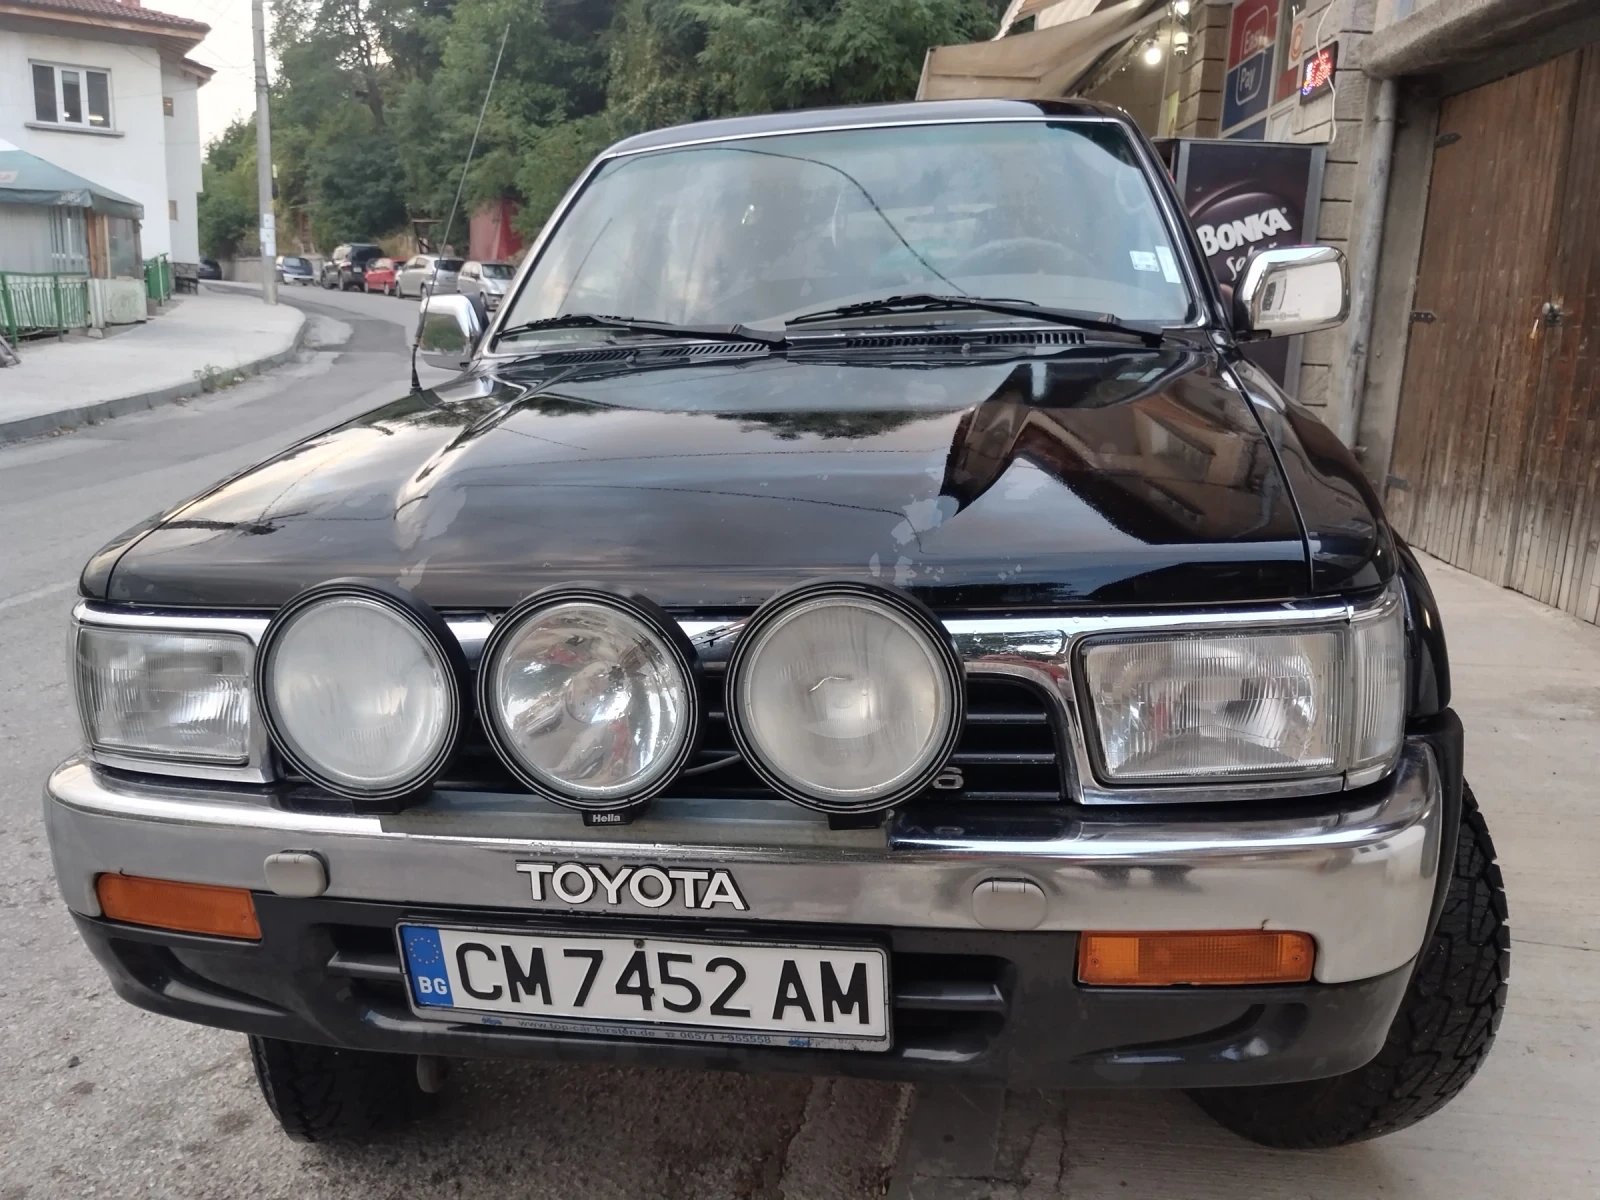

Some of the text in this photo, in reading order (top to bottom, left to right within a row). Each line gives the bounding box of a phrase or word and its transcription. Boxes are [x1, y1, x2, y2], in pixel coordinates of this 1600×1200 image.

[1239, 67, 1257, 91] Pay
[1196, 208, 1292, 257] BONKA
[592, 813, 621, 823] Hella
[515, 860, 751, 912] TOYOTA
[419, 975, 448, 996] BG
